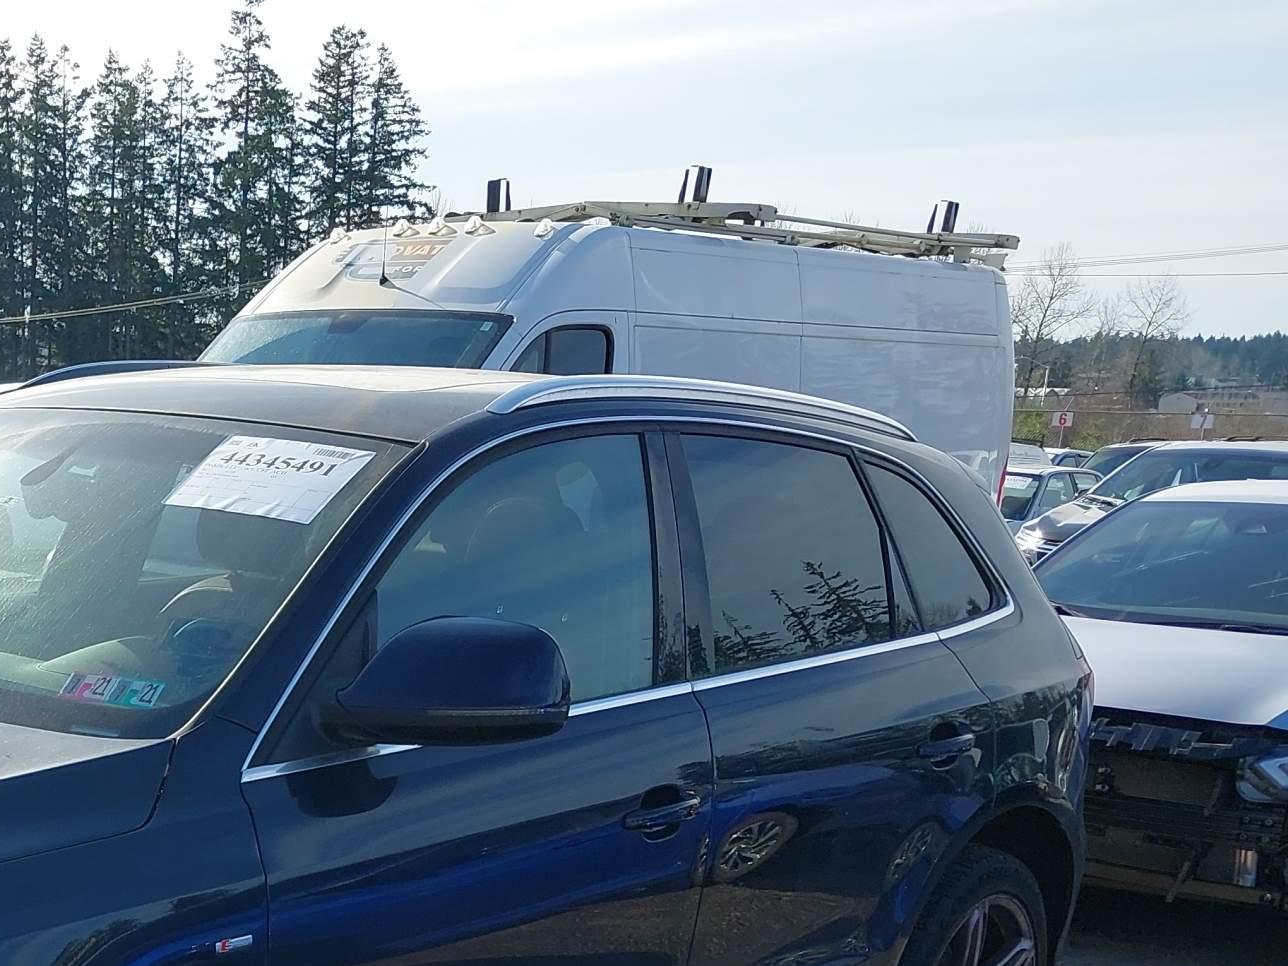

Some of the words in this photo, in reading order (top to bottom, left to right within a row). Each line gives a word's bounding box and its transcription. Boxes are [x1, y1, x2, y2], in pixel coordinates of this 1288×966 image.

[1058, 413, 1068, 426] 6
[220, 451, 338, 477] 44345491
[139, 684, 159, 704] 21
